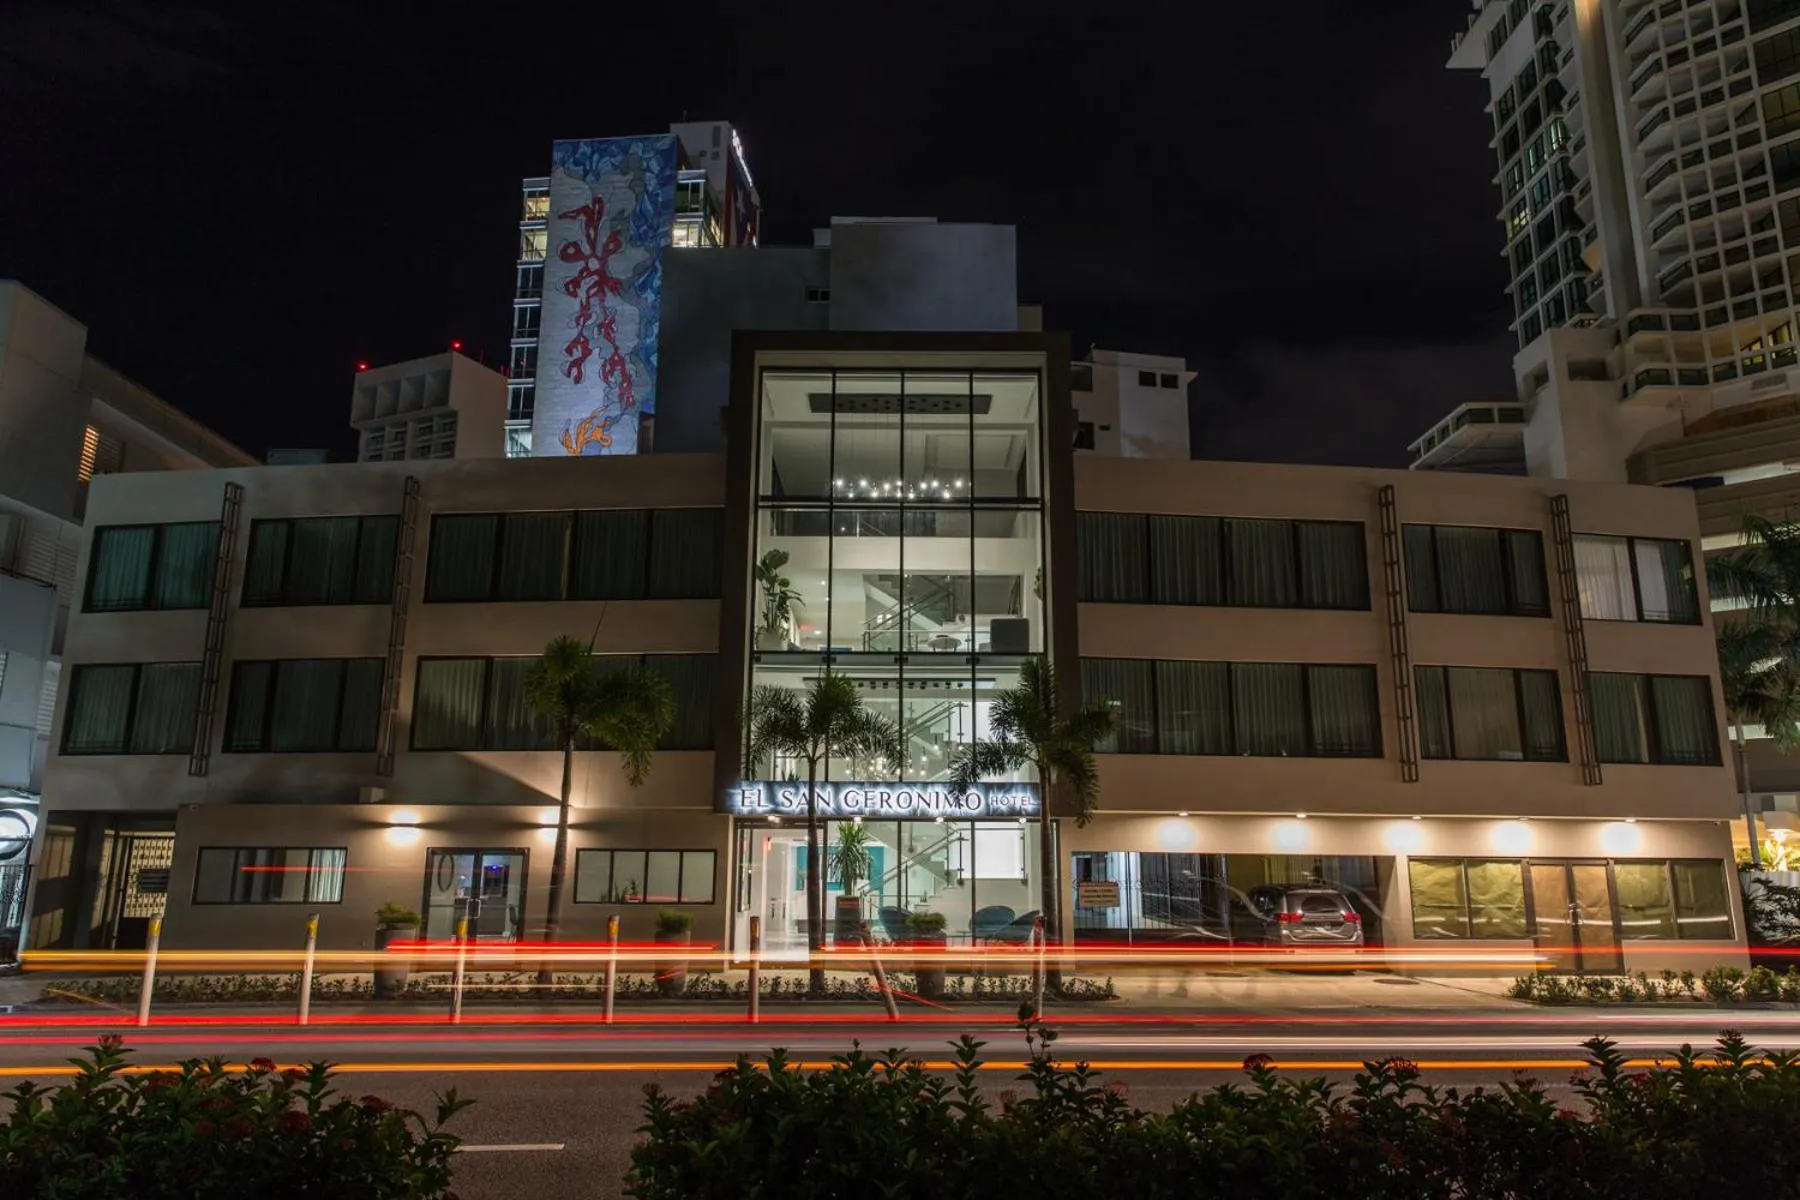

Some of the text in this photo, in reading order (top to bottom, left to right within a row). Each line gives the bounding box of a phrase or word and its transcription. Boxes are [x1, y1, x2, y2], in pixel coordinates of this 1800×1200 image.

[741, 789, 1039, 811] EL SAN GERONIMO HOTEL
